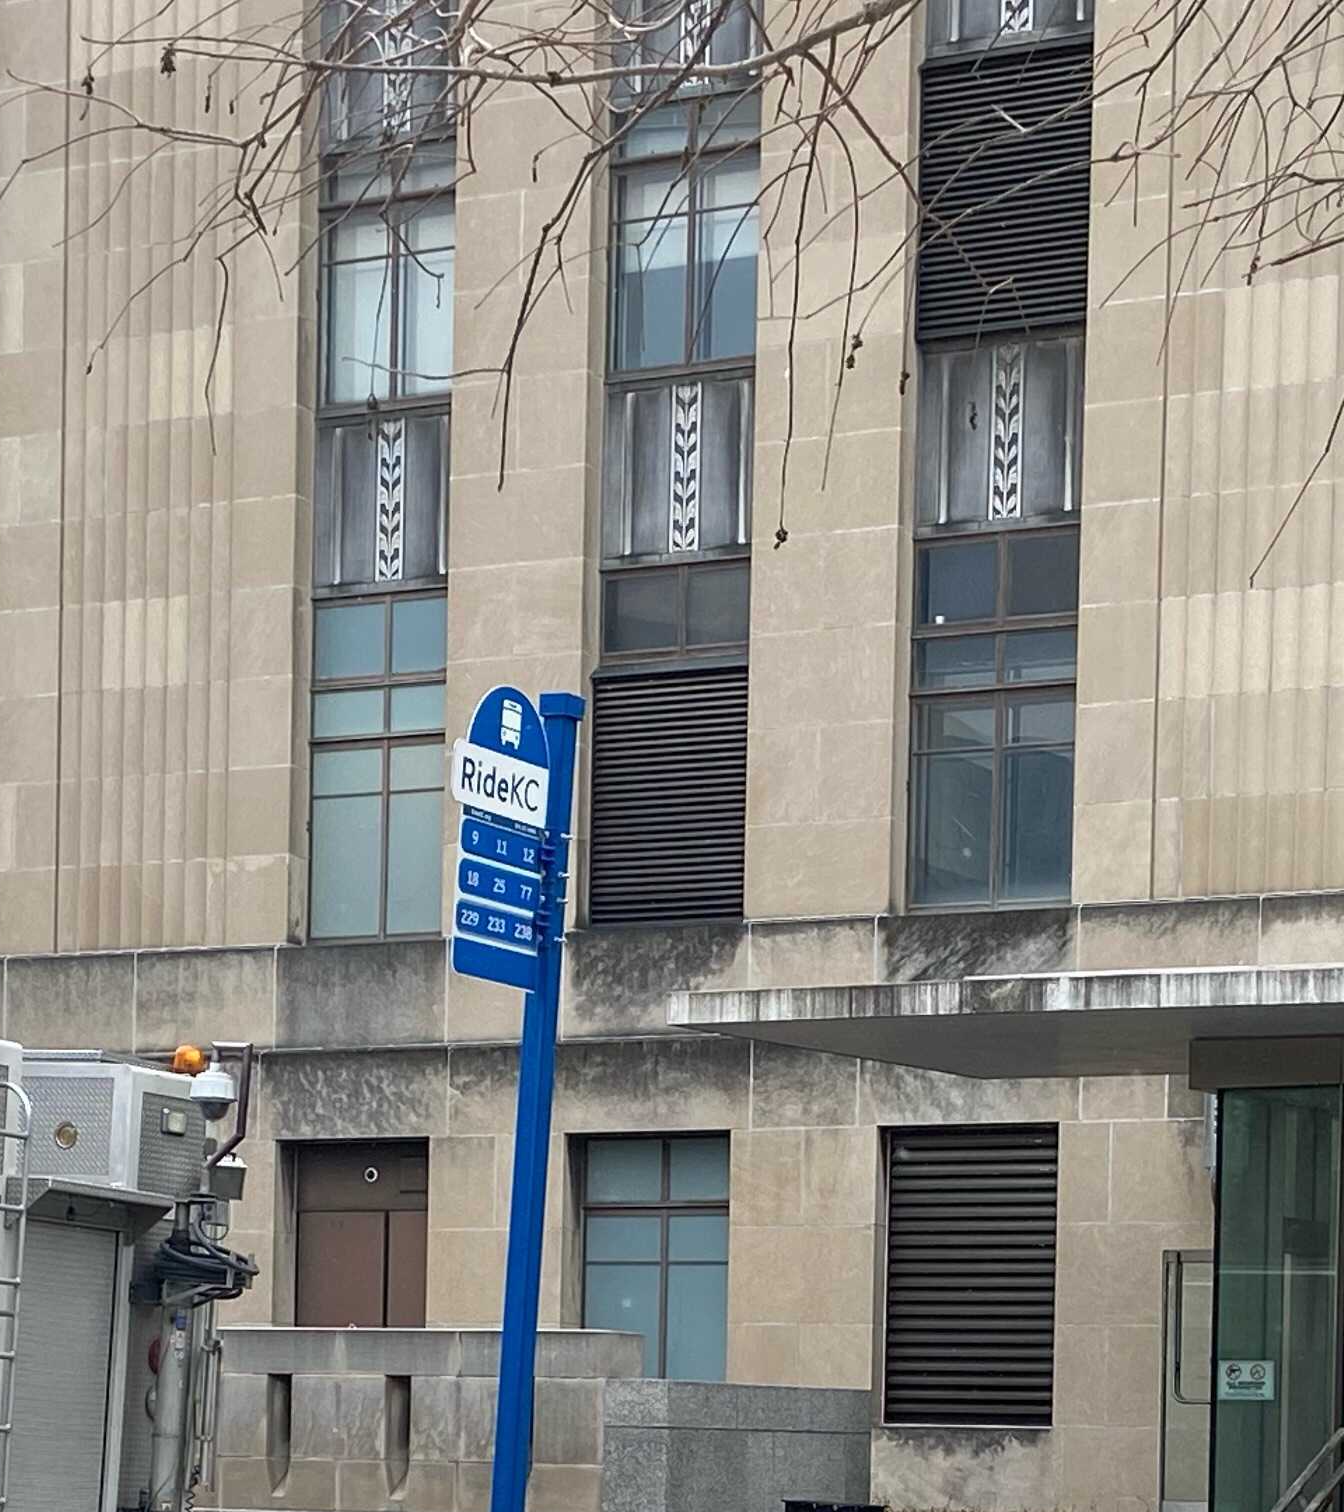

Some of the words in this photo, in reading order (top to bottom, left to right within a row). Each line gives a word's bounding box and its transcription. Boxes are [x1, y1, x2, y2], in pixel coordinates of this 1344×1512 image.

[462, 756, 539, 812] RideKC
[471, 830, 479, 845] 9
[496, 839, 507, 856] 11
[523, 847, 535, 865] 12
[520, 884, 533, 901] 77
